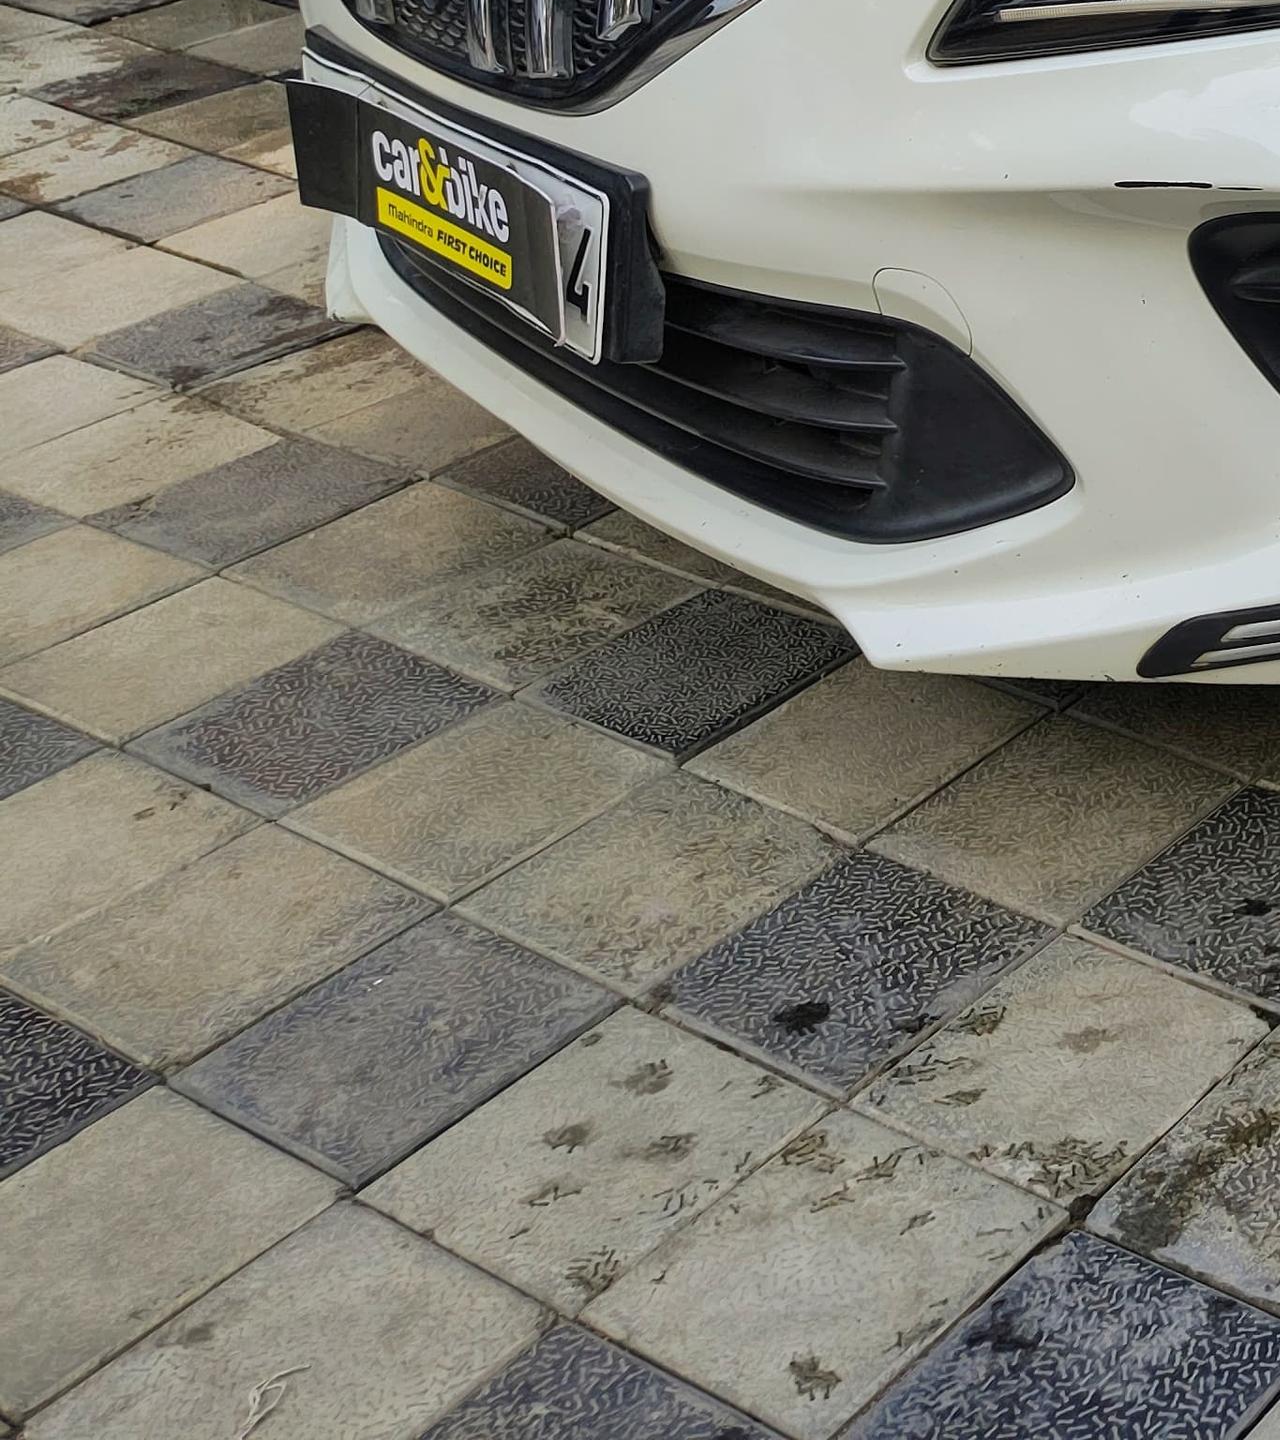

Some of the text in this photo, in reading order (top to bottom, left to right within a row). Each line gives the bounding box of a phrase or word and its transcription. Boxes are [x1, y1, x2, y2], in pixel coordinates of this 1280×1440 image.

[372, 130, 509, 244] car&bike
[437, 229, 468, 257] FIRST
[468, 246, 507, 278] CHOICE
